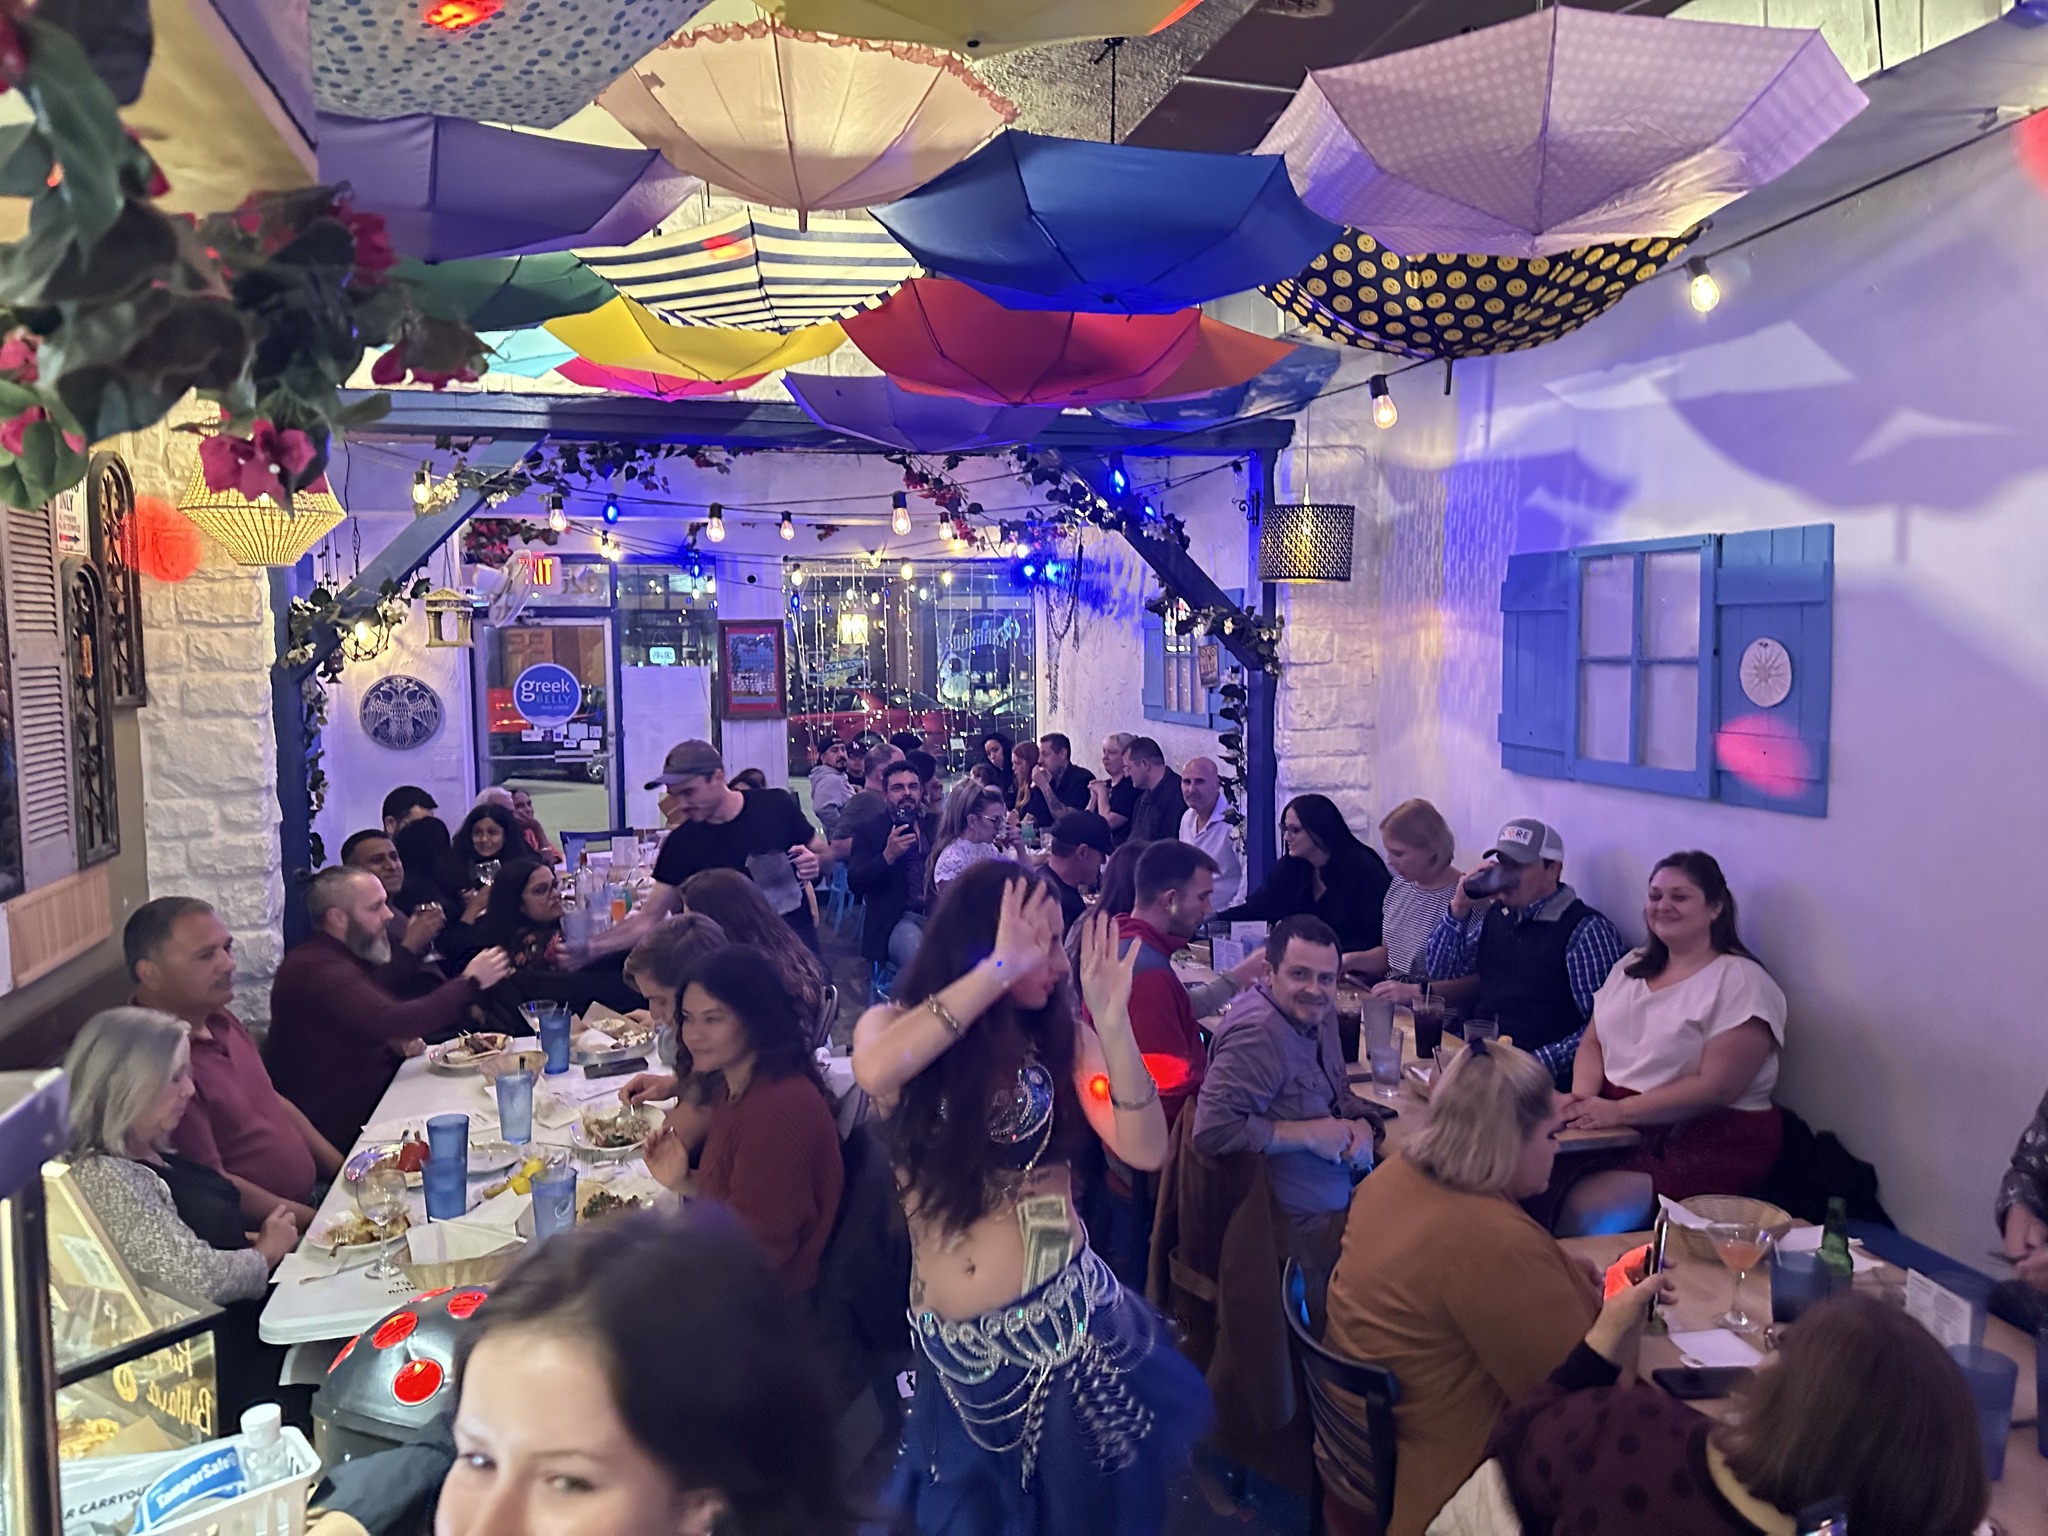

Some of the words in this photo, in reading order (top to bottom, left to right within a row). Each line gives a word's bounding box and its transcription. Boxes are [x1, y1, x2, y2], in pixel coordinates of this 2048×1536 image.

[521, 678, 570, 702] greek
[536, 694, 571, 704] BELLY
[155, 1456, 232, 1510] TamperSafe
